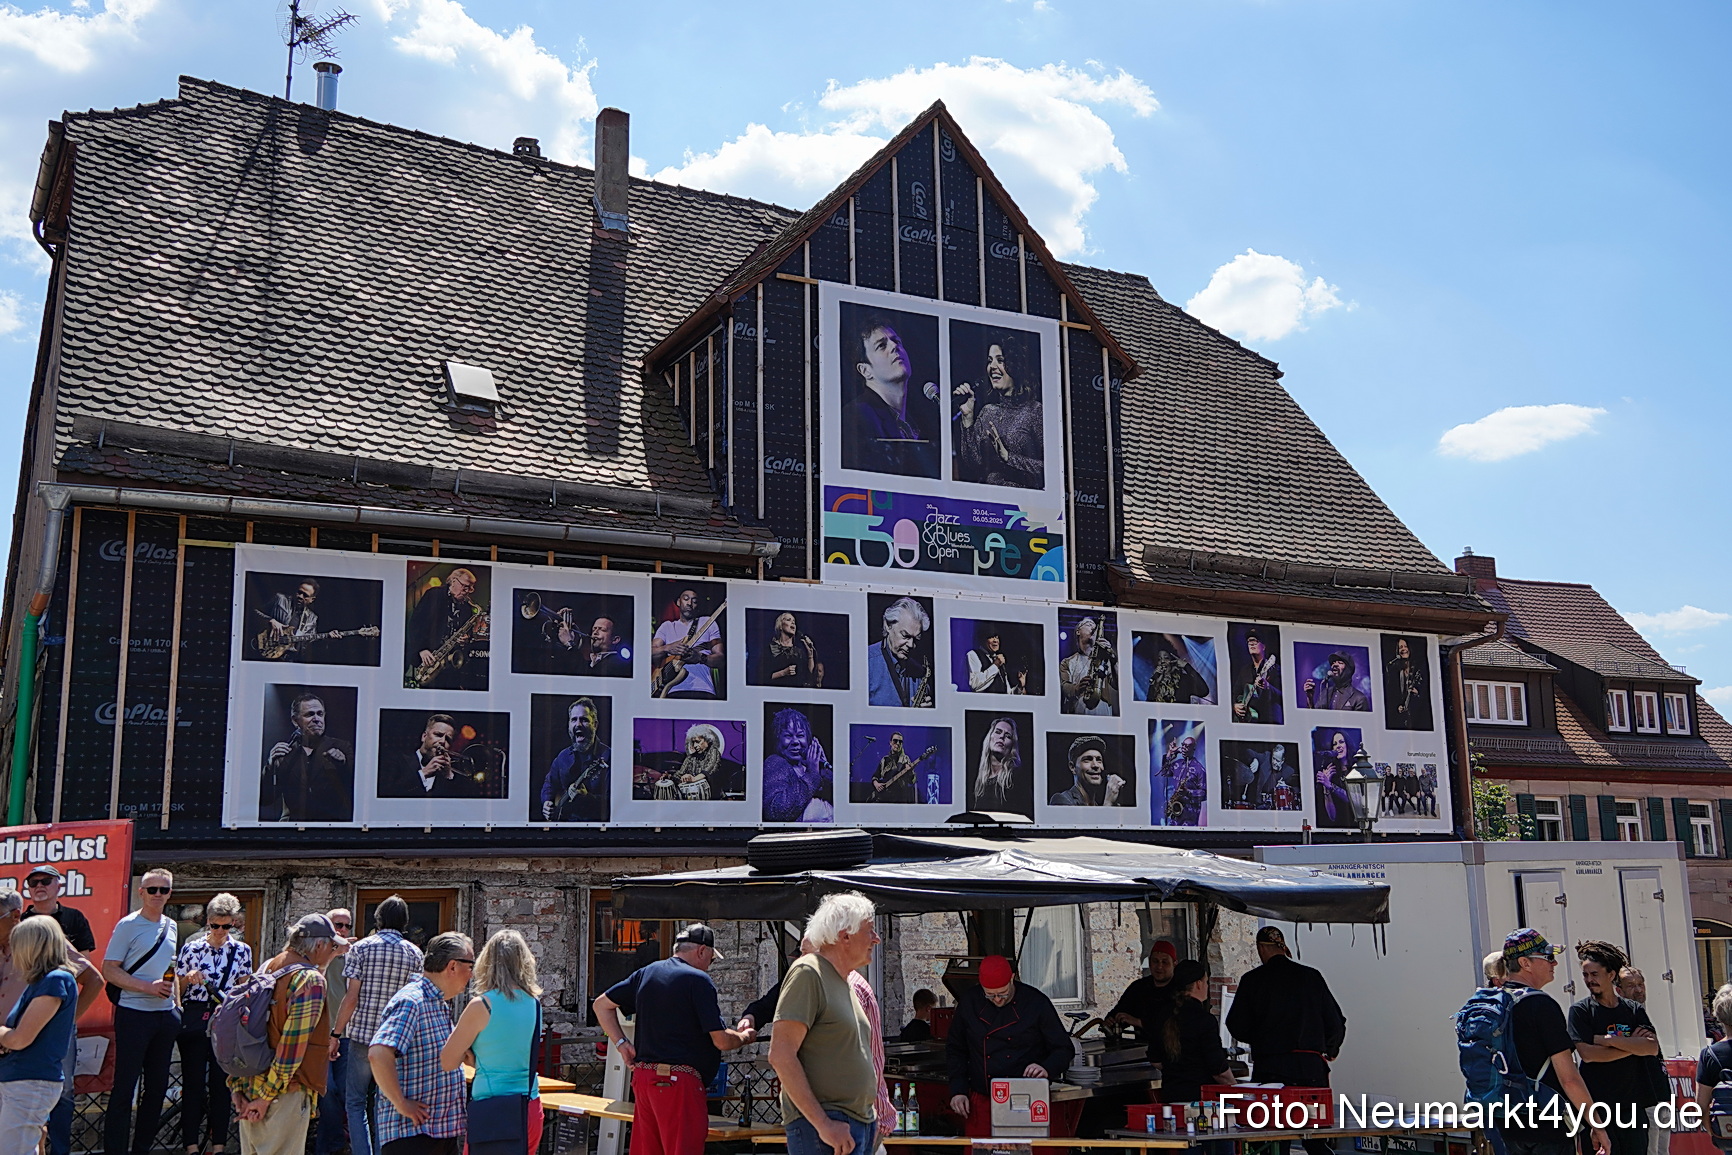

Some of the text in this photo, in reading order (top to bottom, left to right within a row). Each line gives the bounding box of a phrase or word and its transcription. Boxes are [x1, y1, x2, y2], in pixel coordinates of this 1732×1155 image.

[899, 225, 951, 245] CaPlt
[925, 507, 961, 527] Jazz
[927, 542, 960, 565] Open
[143, 638, 152, 646] M
[139, 803, 148, 811] M
[170, 803, 185, 811] SK
